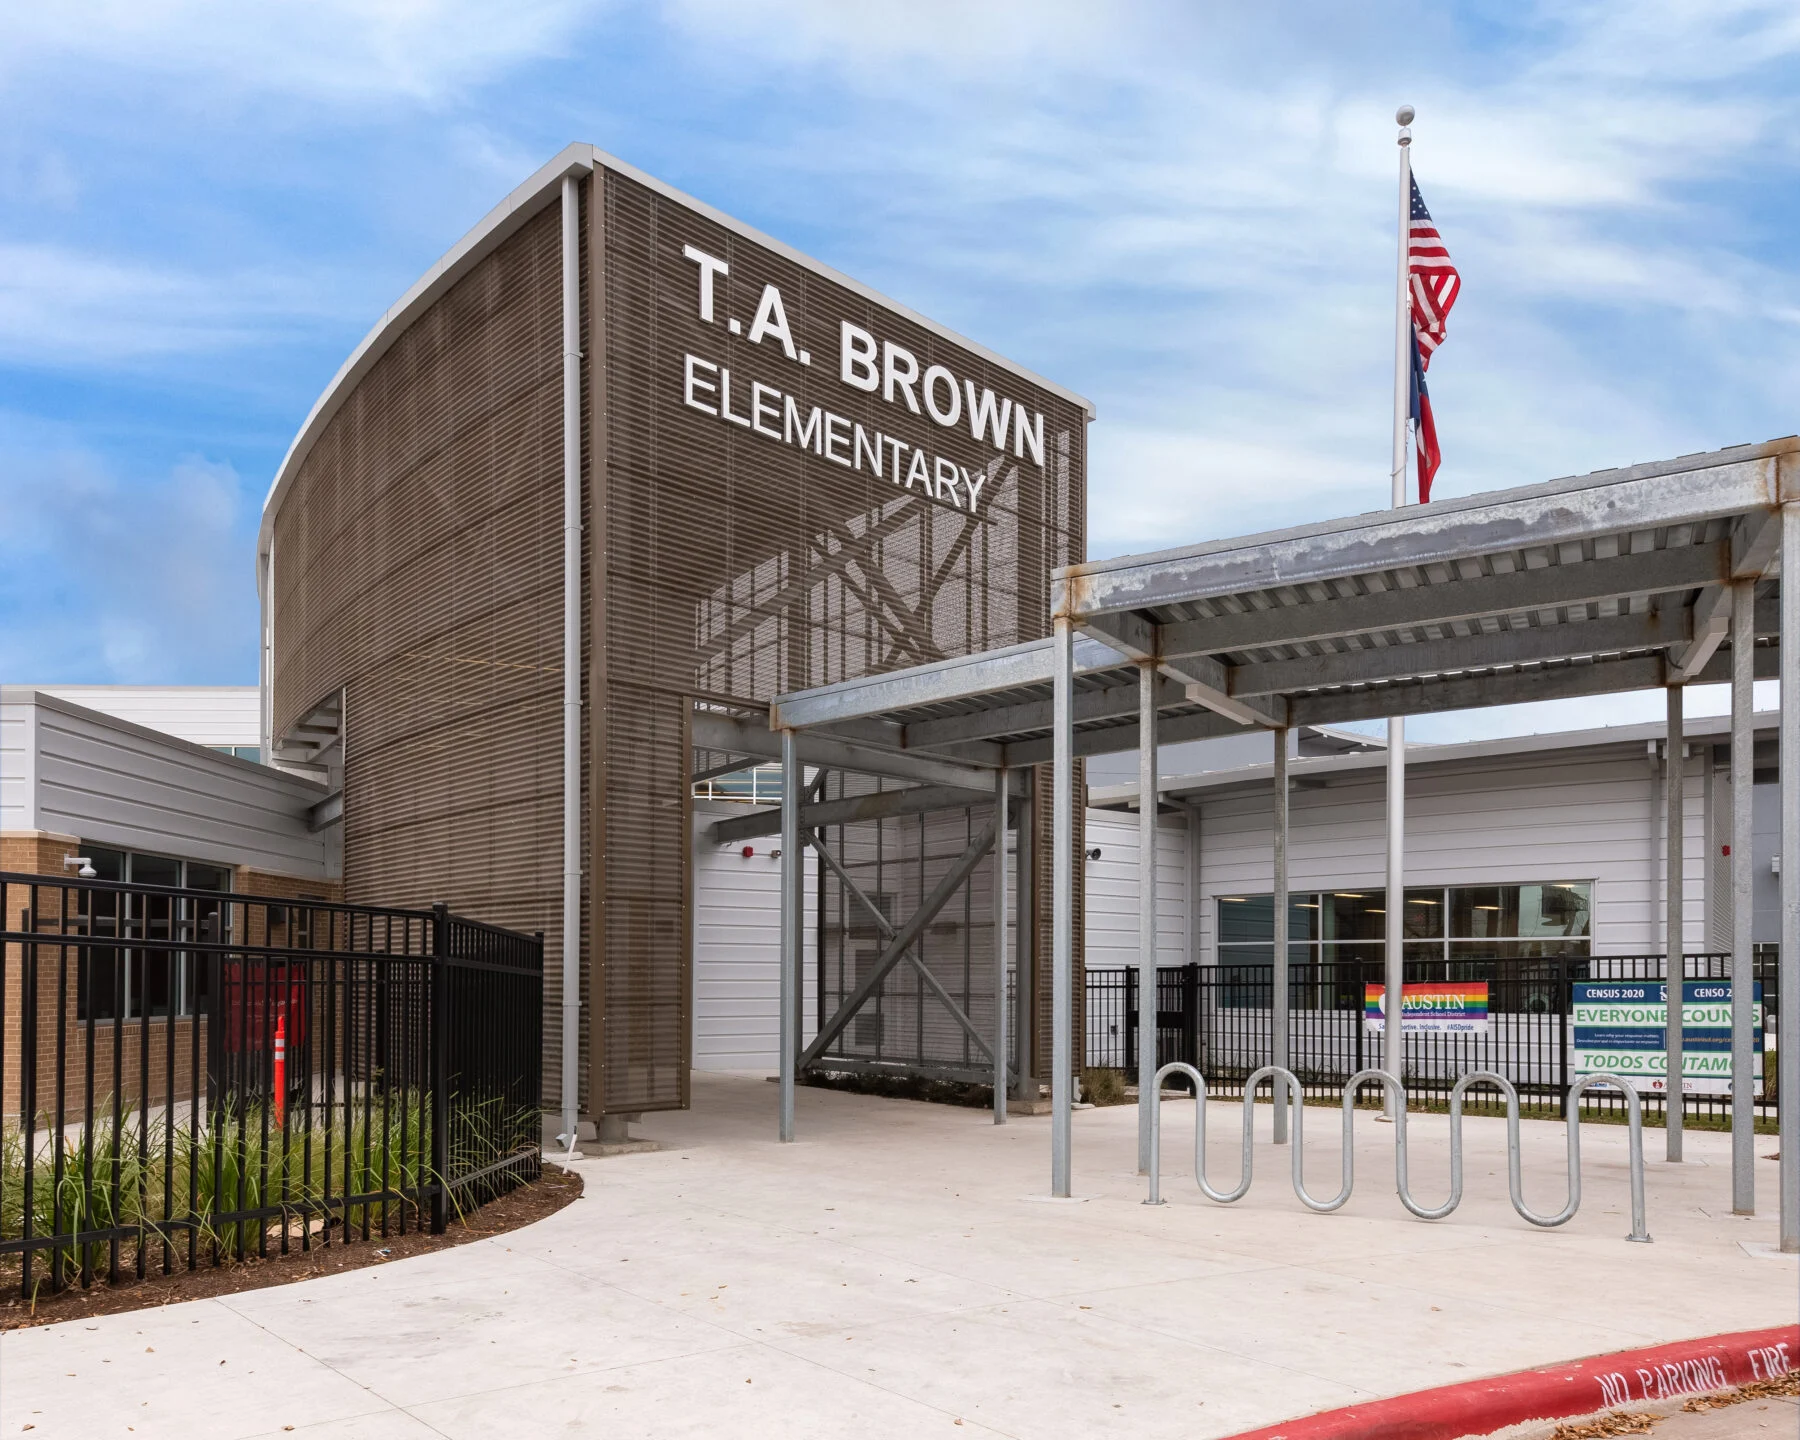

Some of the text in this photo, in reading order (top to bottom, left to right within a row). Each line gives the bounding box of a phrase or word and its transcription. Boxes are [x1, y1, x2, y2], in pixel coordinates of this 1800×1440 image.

[682, 244, 1044, 467] T.A. BROWN
[683, 353, 987, 513] ELEMENTARY
[1586, 989, 1644, 998] CENSUS 2020
[1694, 988, 1724, 998] CENSO
[1401, 994, 1465, 1009] AUSTIN
[1576, 1009, 1759, 1022] EVERYONE COUNS
[1584, 1055, 1643, 1068] TODOS
[1594, 1343, 1790, 1408] NO PARKING FIRE
